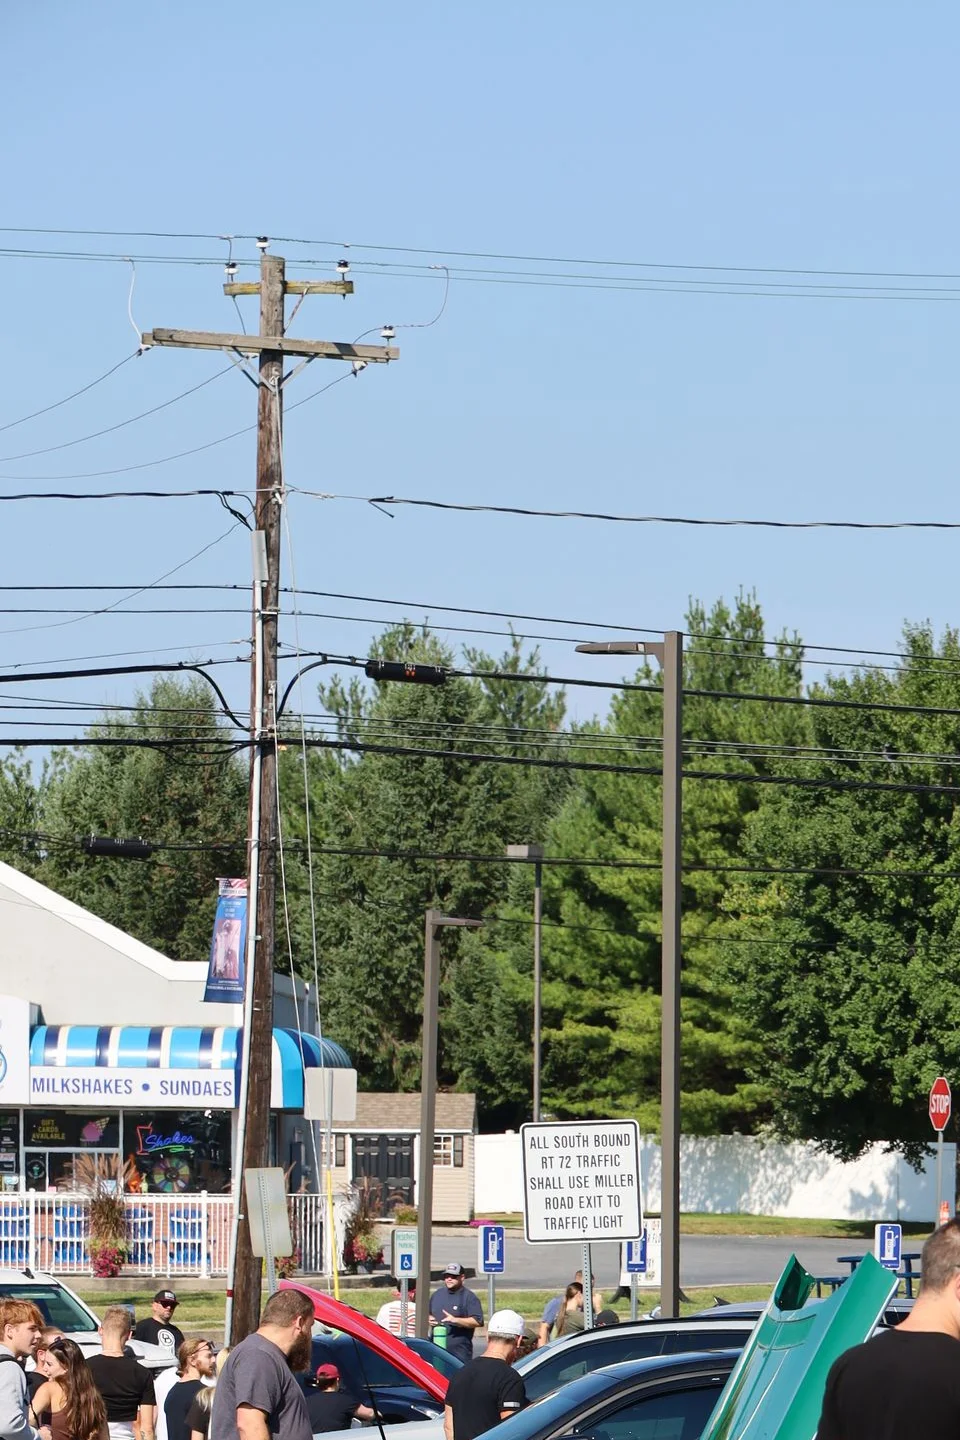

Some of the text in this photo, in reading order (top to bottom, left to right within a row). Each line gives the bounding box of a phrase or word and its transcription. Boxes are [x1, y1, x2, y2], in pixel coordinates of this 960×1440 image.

[32, 1077, 232, 1097] MILKSHAKES SUNDAES
[931, 1094, 949, 1114] STOP
[32, 1132, 65, 1140] AVAILABLE
[145, 1130, 193, 1149] Shakes
[530, 1133, 631, 1150] ALL SOUTH BOUND
[541, 1154, 620, 1169] RT 72 TRAFFIC
[530, 1174, 634, 1190] SHALL USE MILLER
[545, 1195, 621, 1210] ROAD EXIT TO
[544, 1215, 623, 1230] TRAFFIC LIGHT
